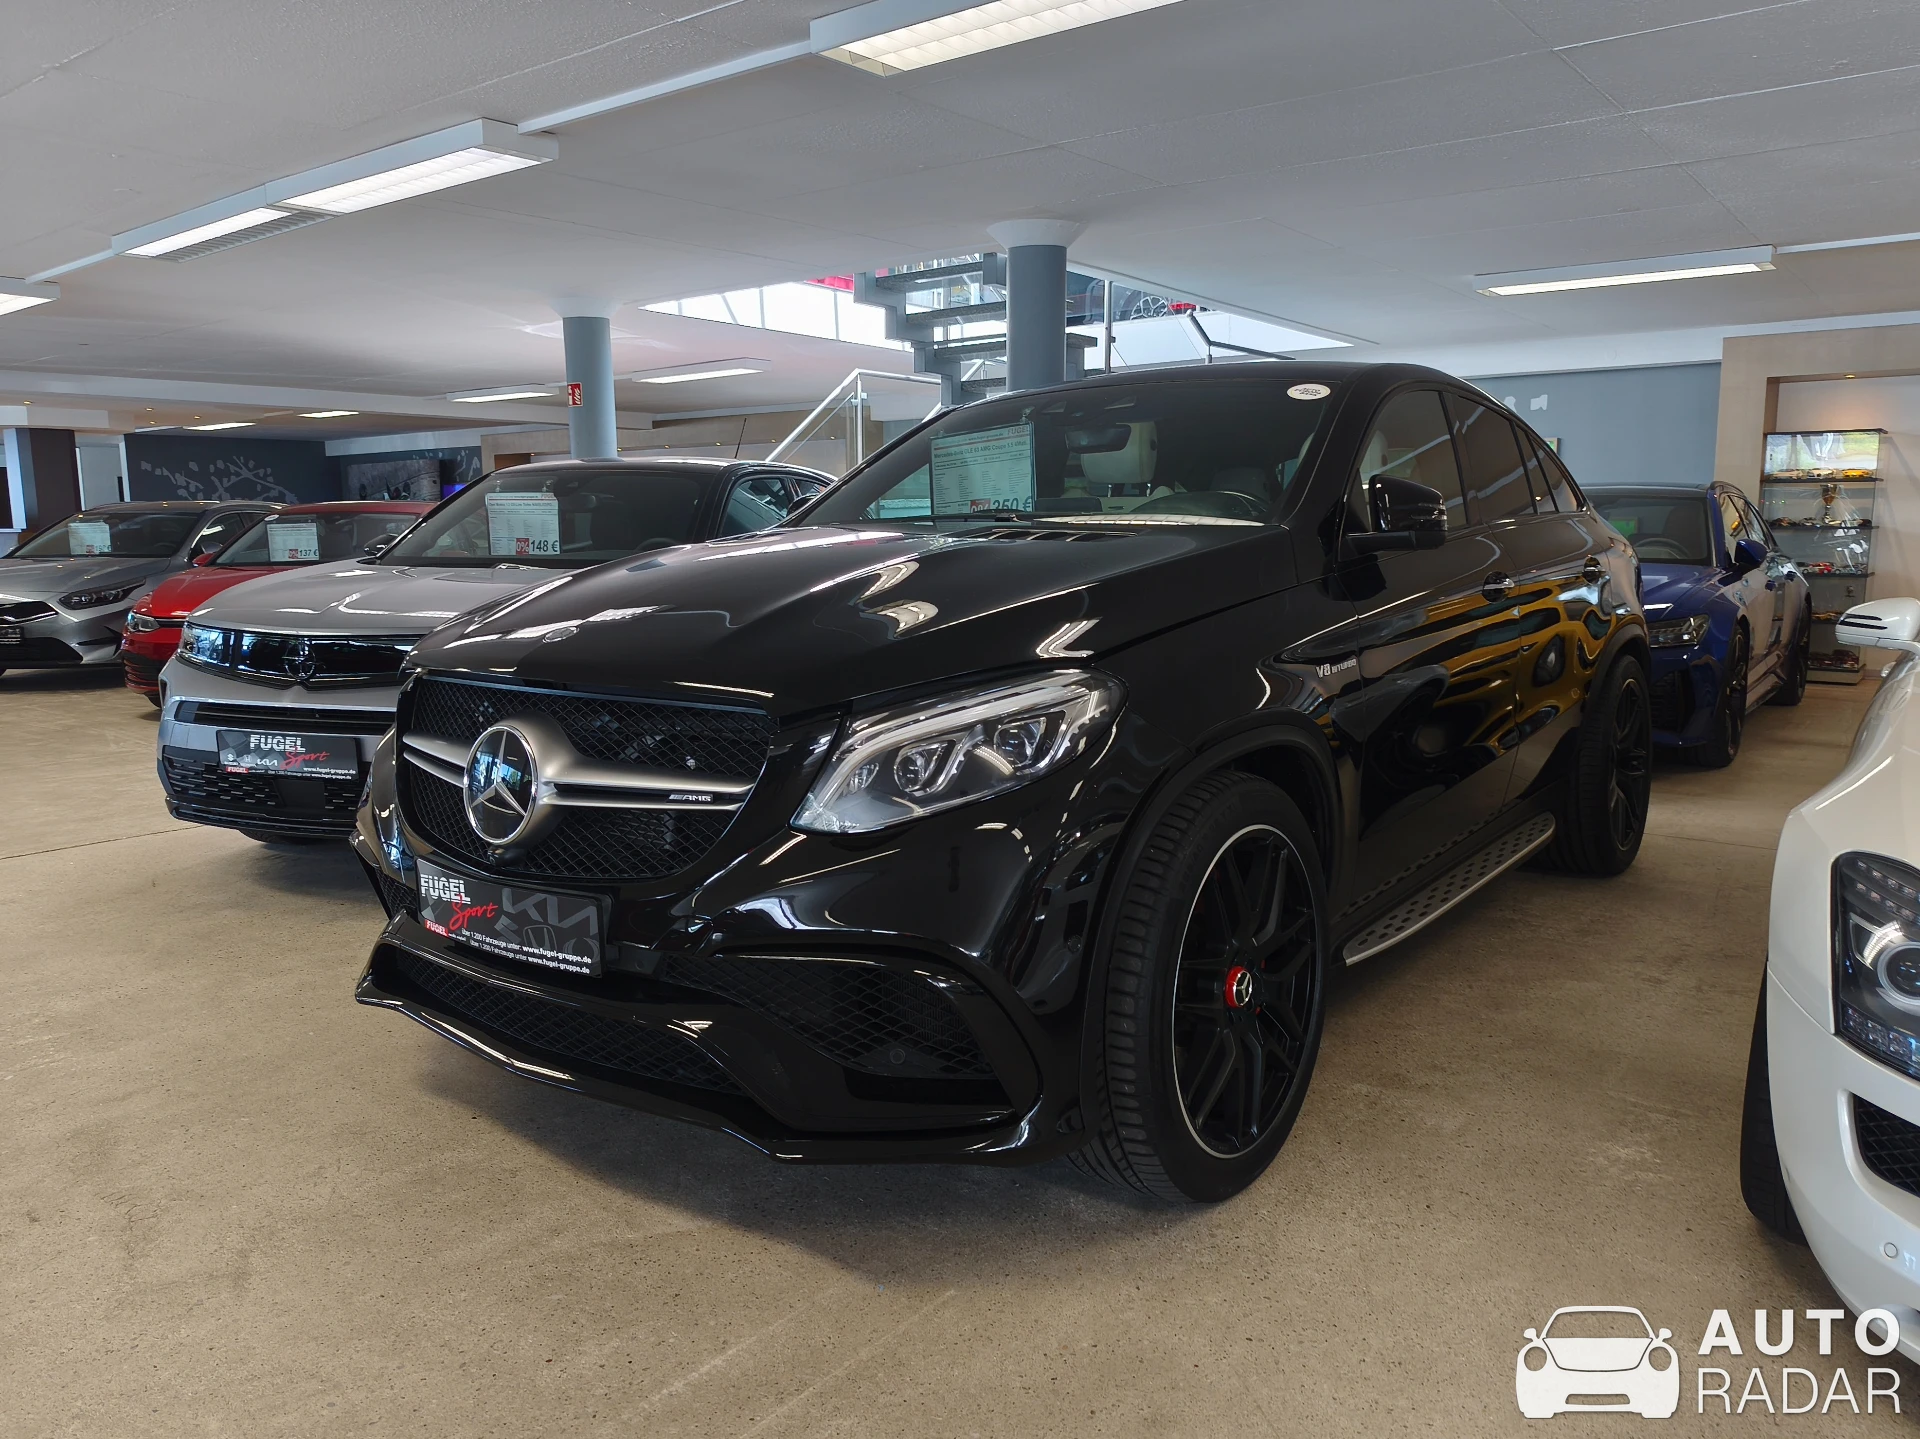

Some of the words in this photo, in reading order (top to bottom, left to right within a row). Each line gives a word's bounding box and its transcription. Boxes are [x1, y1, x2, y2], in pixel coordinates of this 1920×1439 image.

[516, 542, 529, 552] 0%
[530, 540, 548, 552] 148
[552, 540, 558, 552] €
[1316, 663, 1331, 678] V8
[250, 735, 306, 752] FUGEL
[280, 747, 330, 770] Sport
[420, 874, 471, 905] FUGEL
[450, 893, 499, 930] Sport
[426, 920, 448, 936] FUGEL
[482, 935, 507, 948] Fahrzeuge
[522, 946, 592, 964] www.fugel-gruppe.de
[491, 946, 515, 959] Fahrzeuge
[528, 956, 590, 974] www.fugel-gruppe.de
